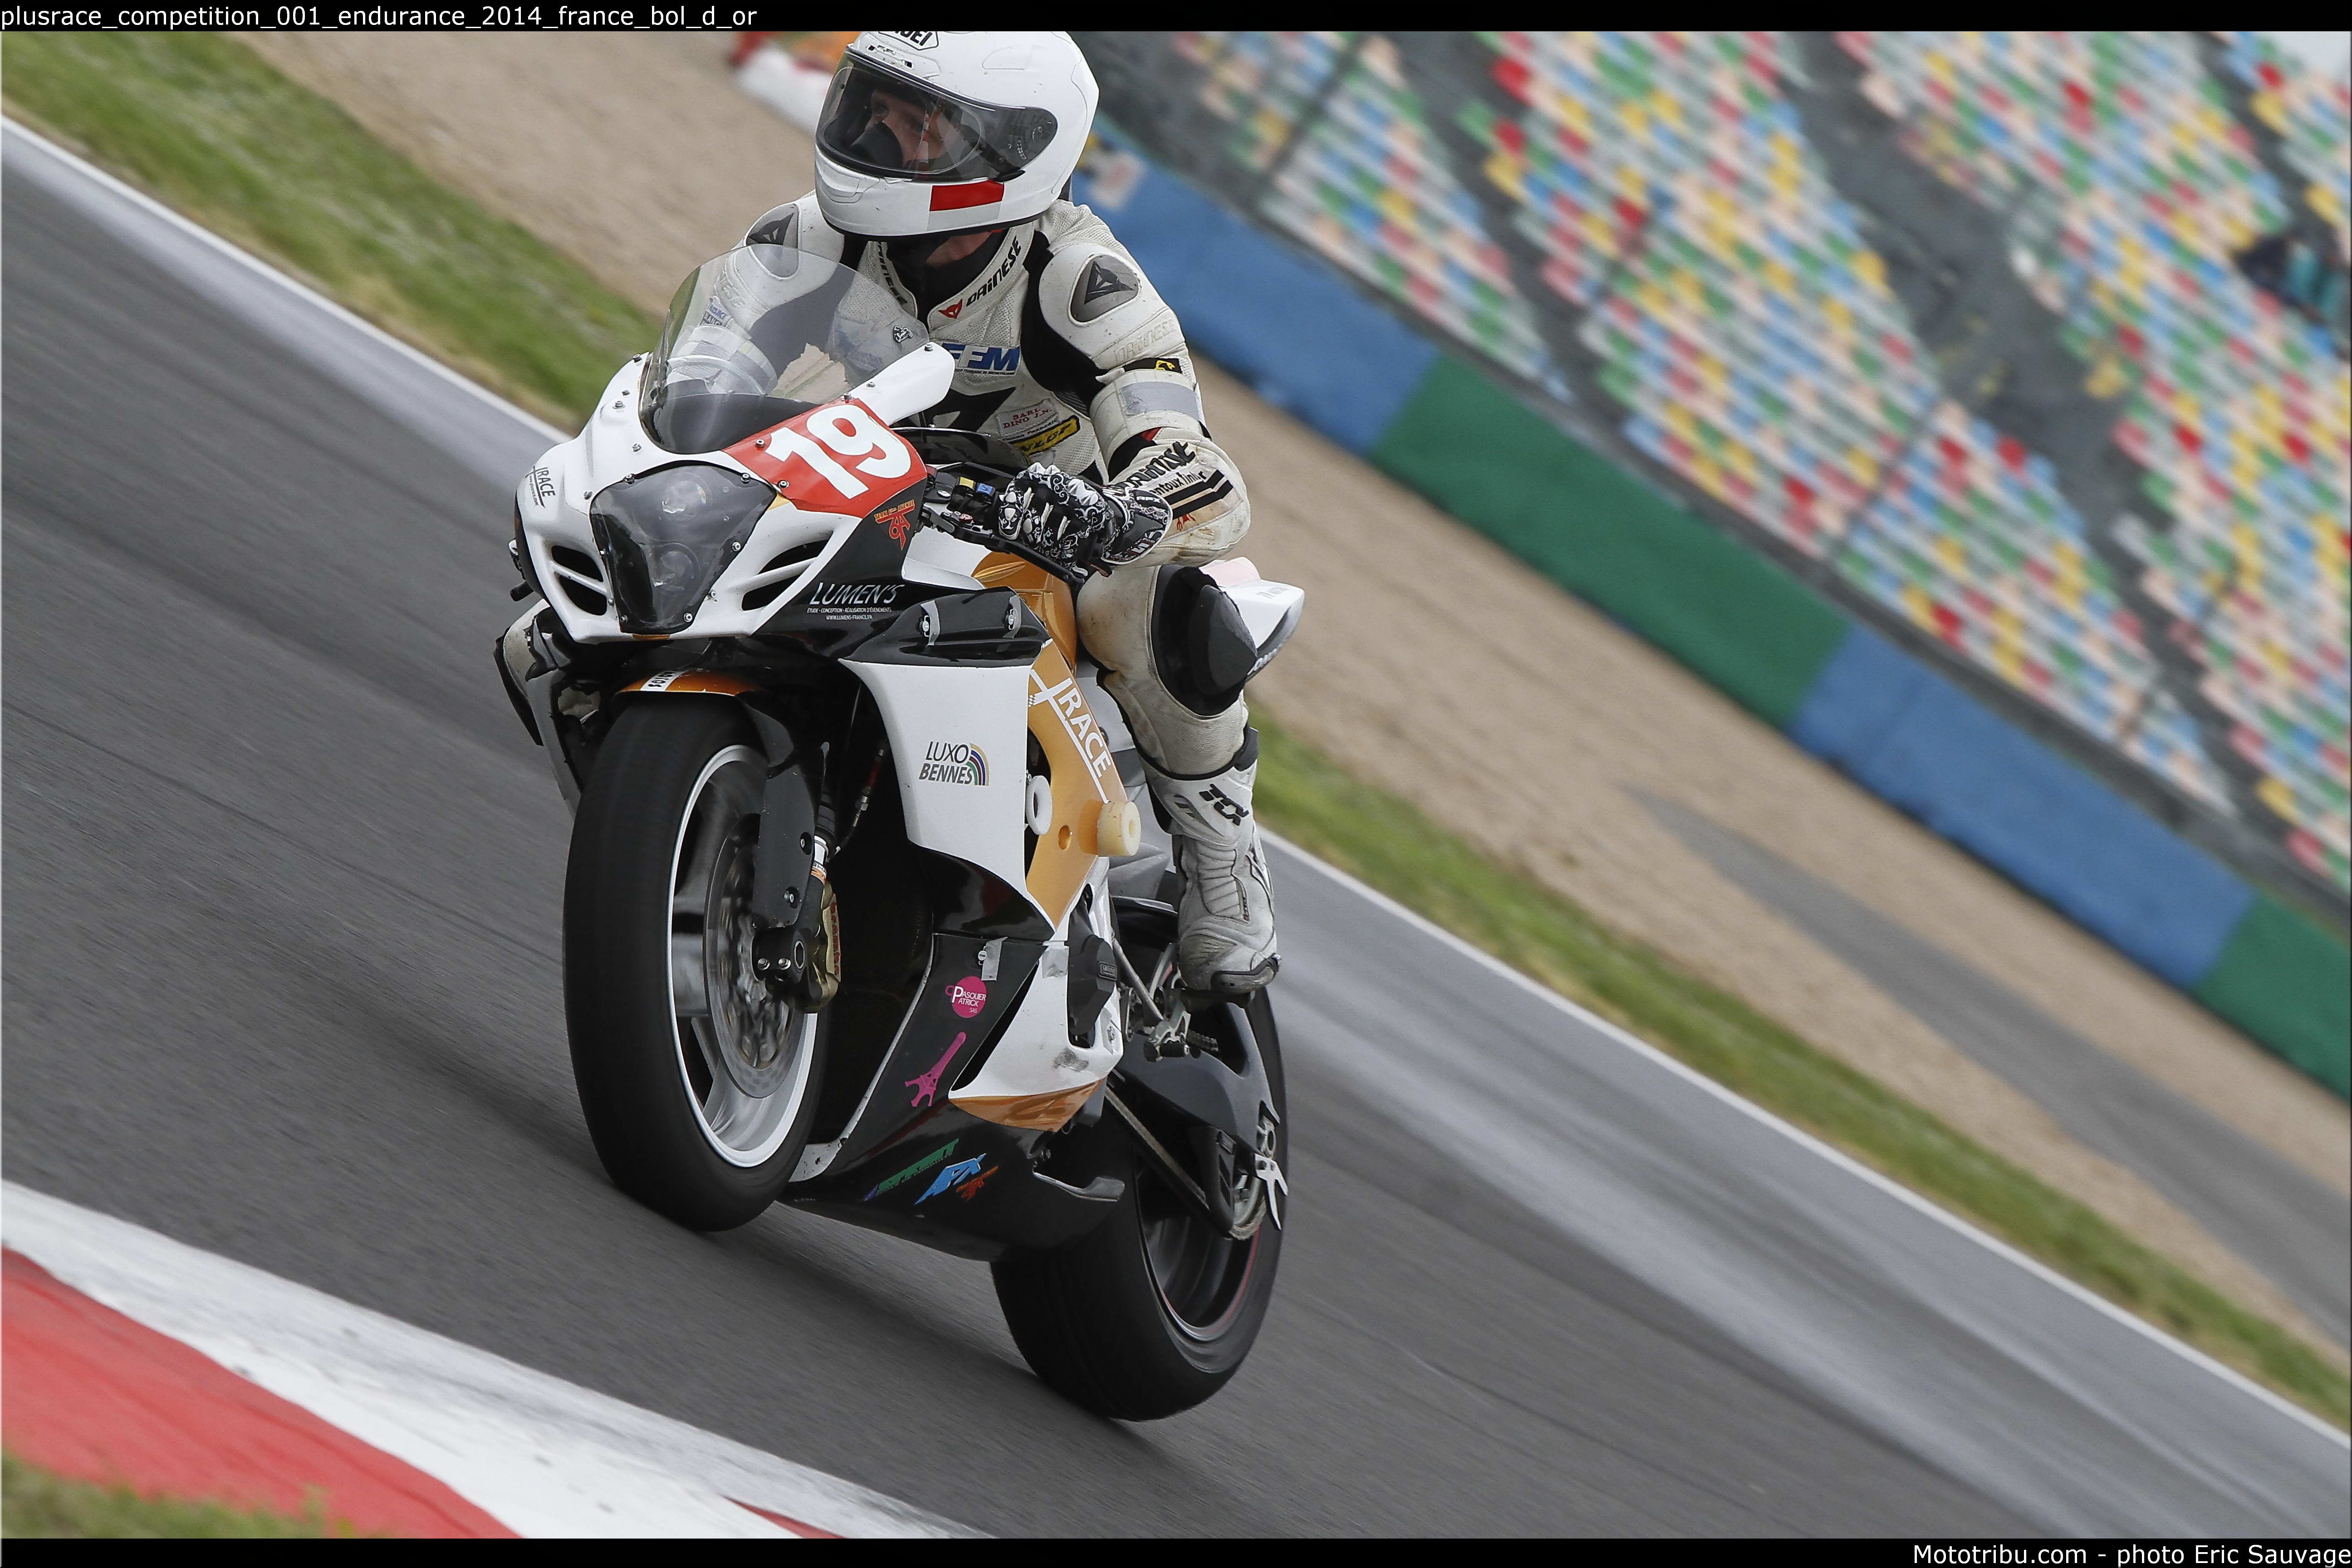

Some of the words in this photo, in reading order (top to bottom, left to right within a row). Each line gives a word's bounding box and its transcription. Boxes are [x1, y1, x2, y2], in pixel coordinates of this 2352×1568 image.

[1003, 417, 1029, 428] DINO
[1013, 408, 1040, 421] SARL
[764, 404, 911, 499] 19
[809, 582, 906, 605] LUMEN'S
[926, 741, 969, 764] LUXO
[918, 763, 973, 785] BENNES
